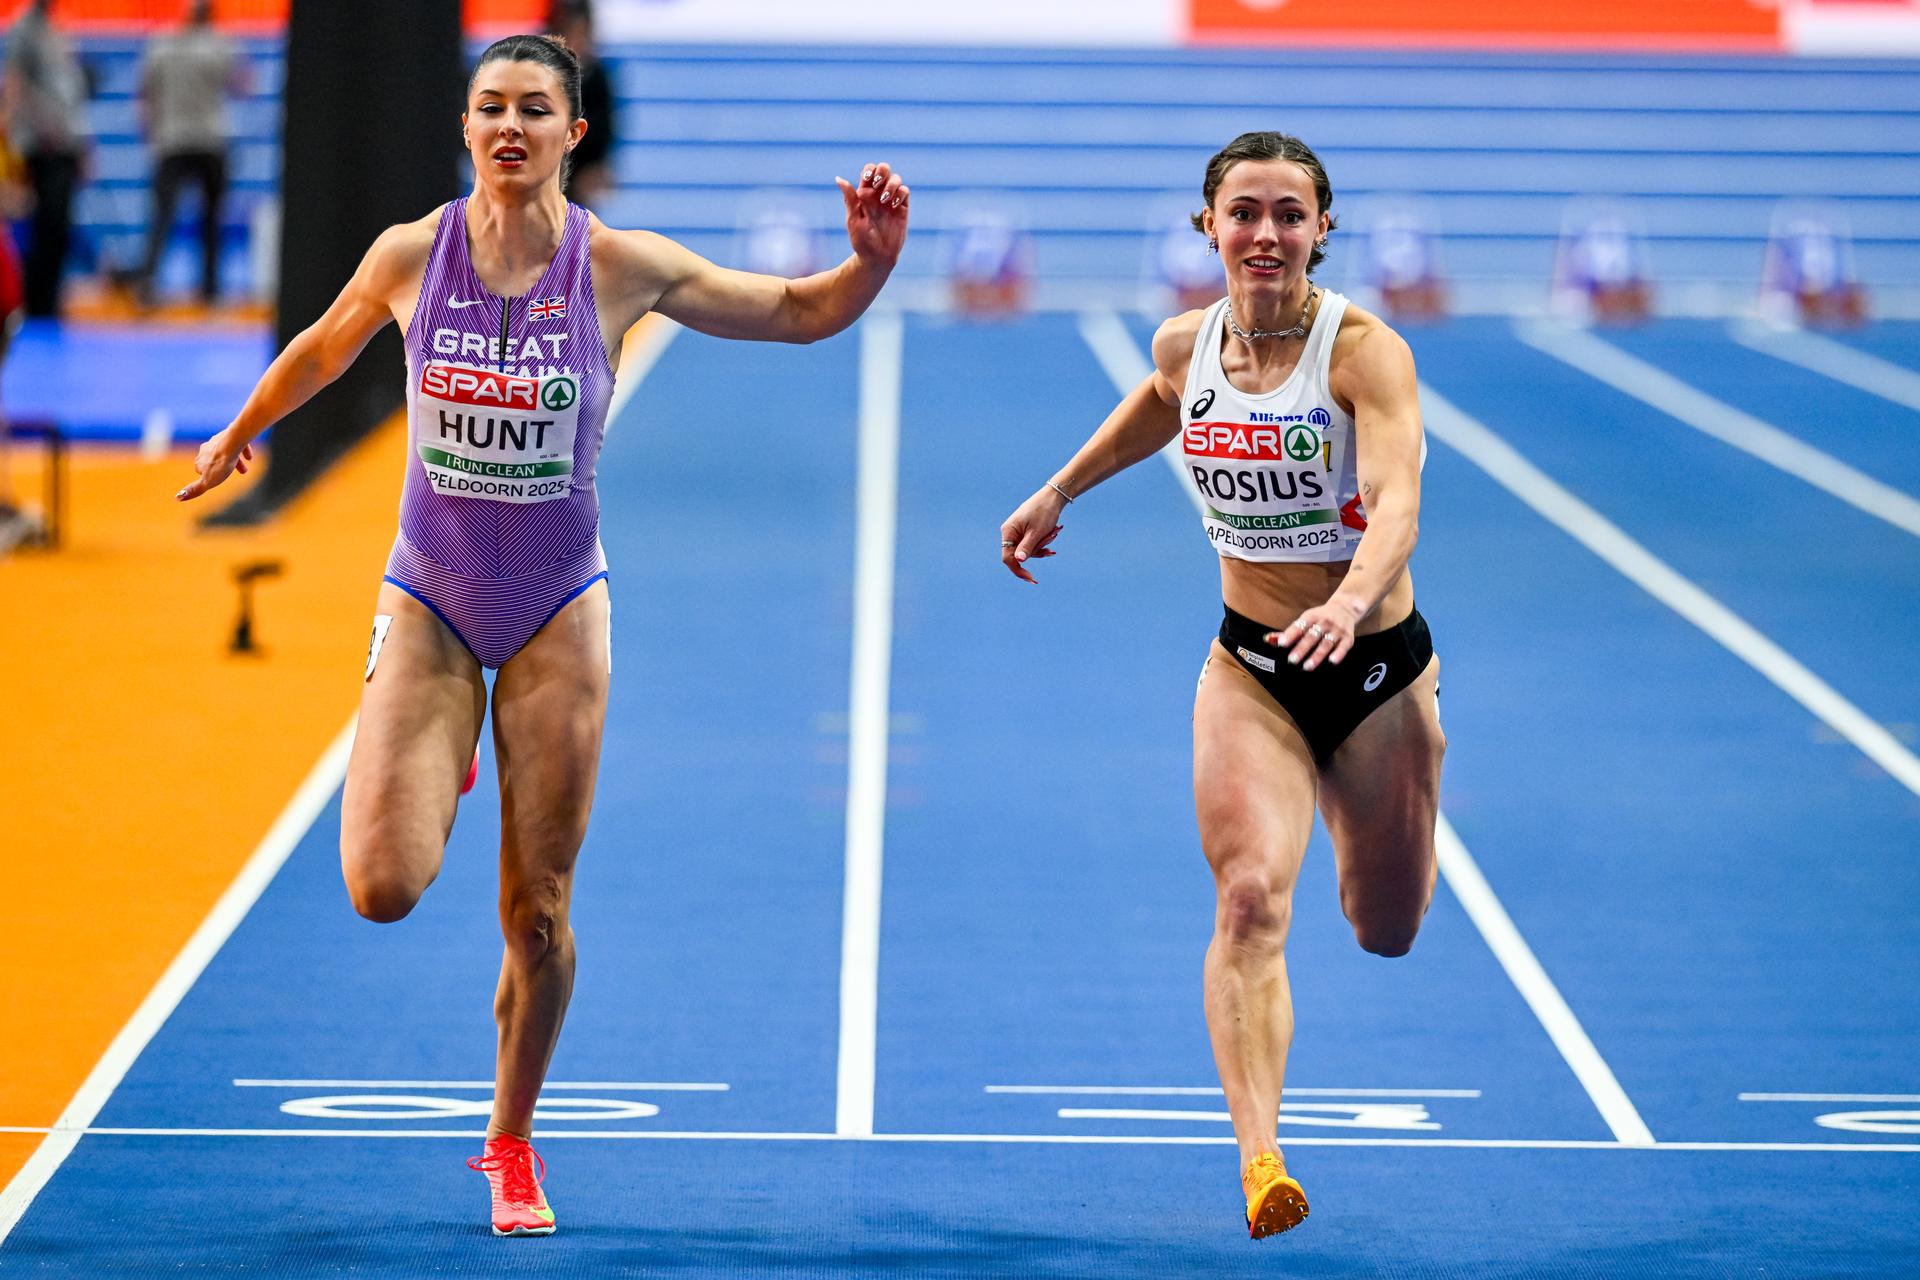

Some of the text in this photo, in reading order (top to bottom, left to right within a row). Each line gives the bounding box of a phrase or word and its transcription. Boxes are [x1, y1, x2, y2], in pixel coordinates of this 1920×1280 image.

[433, 328, 568, 362] GREAT
[424, 367, 534, 405] SPAR
[439, 410, 554, 451] HUNT
[1185, 426, 1279, 455] SPAR
[446, 457, 451, 467] I
[453, 458, 482, 474] RUN
[426, 471, 565, 497] PELDOORN 2025
[1192, 465, 1323, 502] ROSIUS
[1224, 515, 1250, 528] RUN
[1206, 525, 1338, 550] APELDOORN 2025
